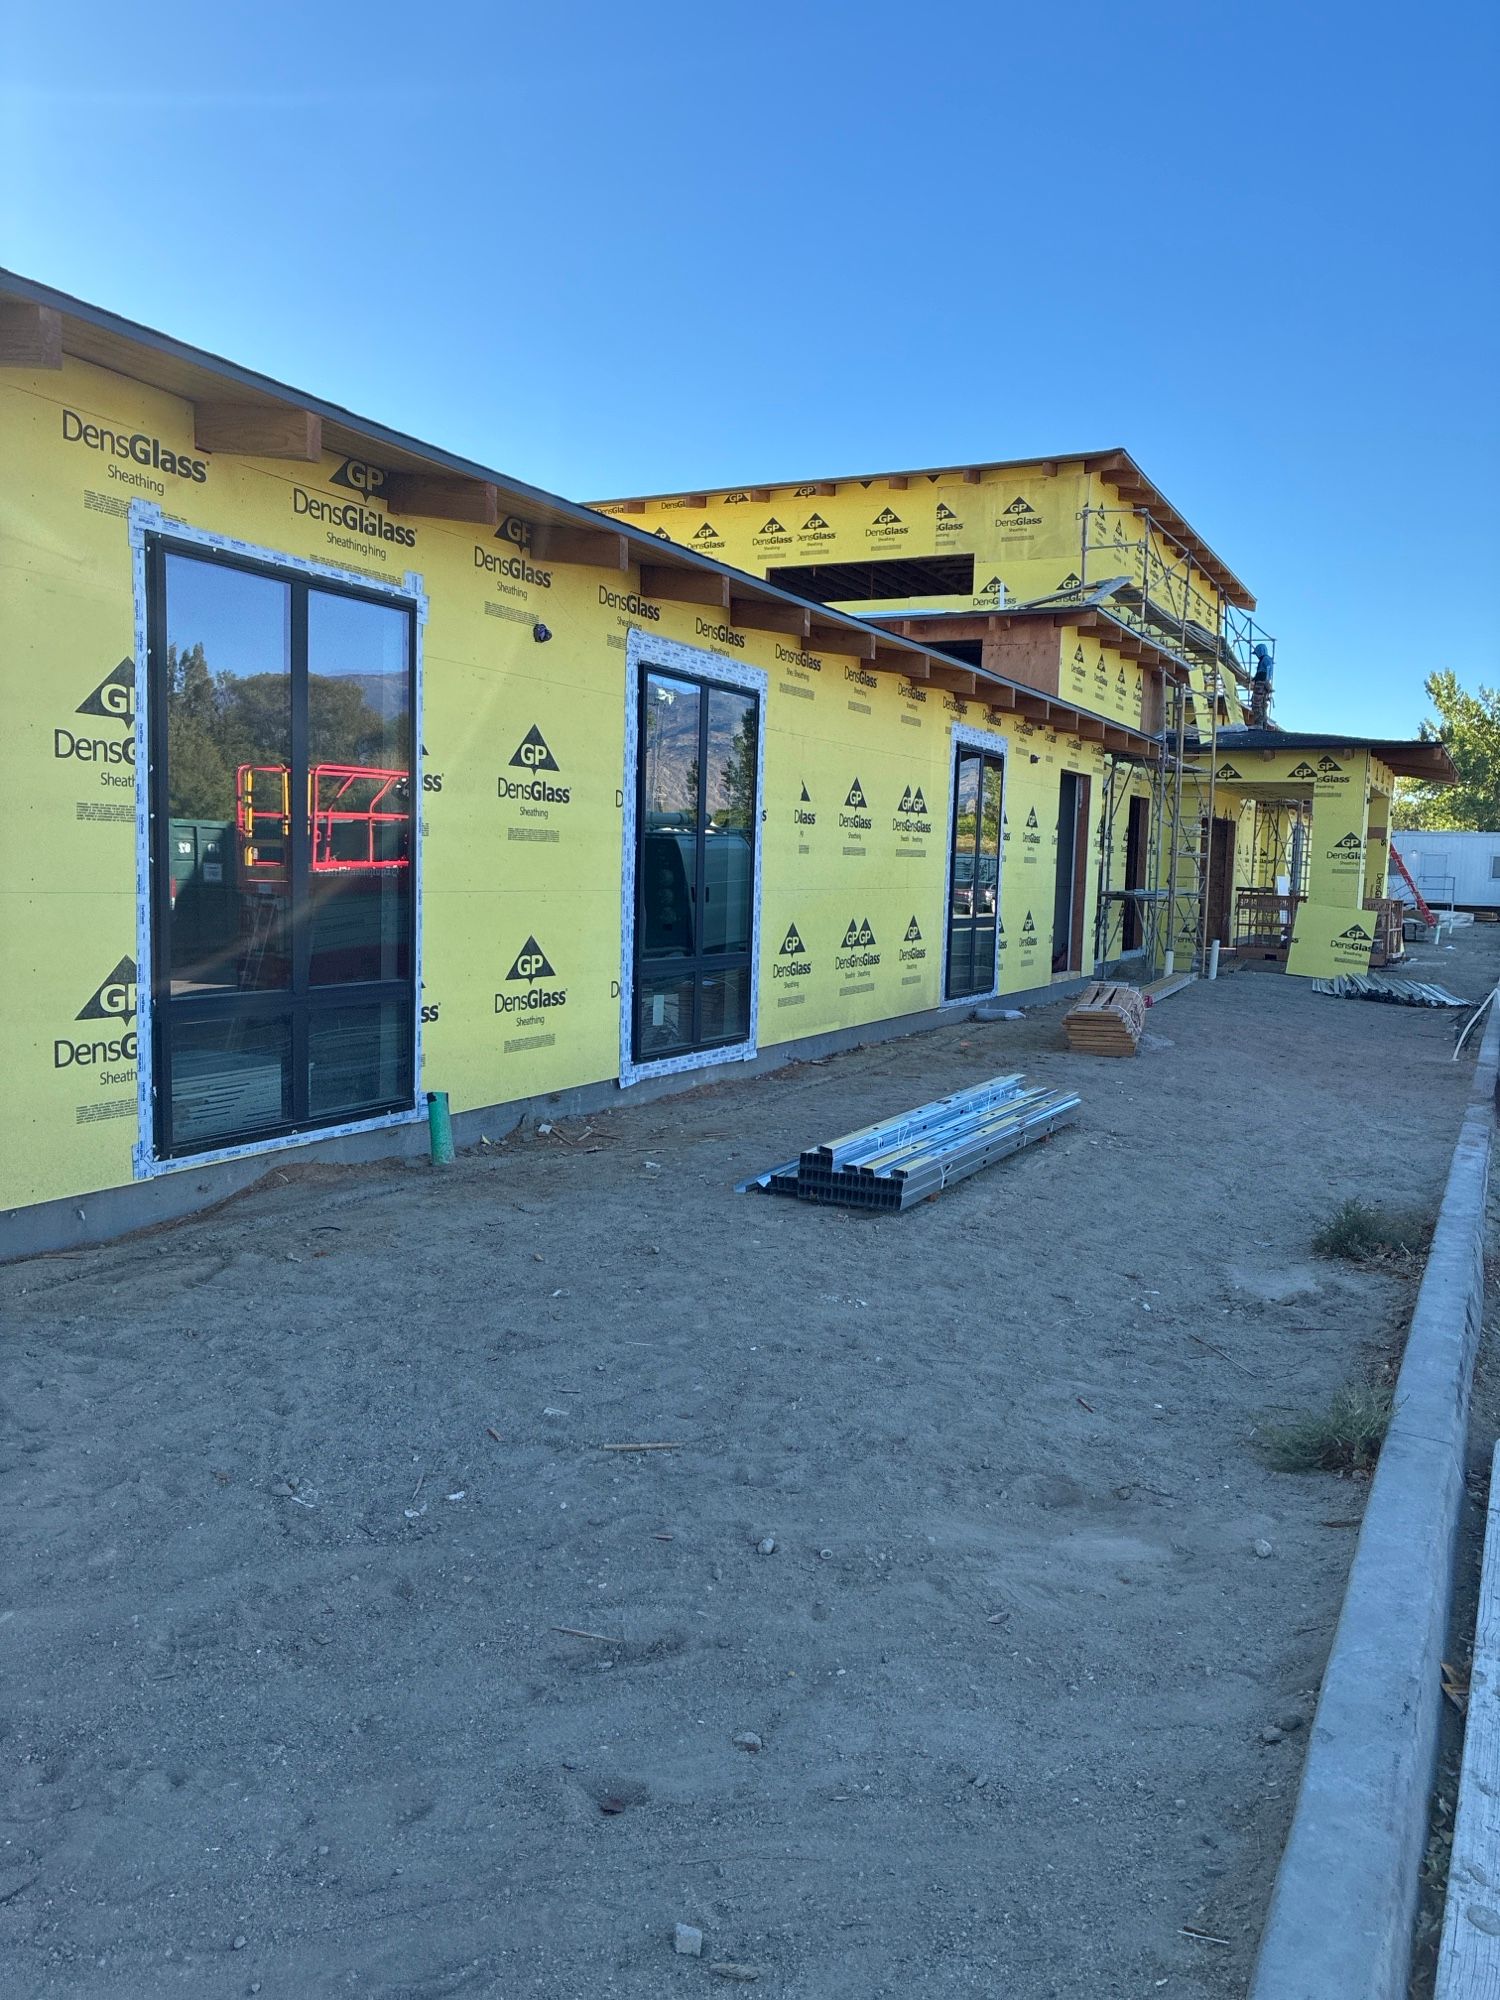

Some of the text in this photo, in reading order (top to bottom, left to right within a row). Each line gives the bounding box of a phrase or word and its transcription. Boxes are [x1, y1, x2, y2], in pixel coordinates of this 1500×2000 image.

[62, 409, 207, 483] DensGlass
[108, 465, 164, 496] Sheathing
[347, 460, 384, 491] GP
[800, 486, 814, 496] GP
[729, 494, 743, 502] GP
[1009, 503, 1027, 513] GP
[807, 519, 823, 529] GP
[878, 514, 895, 523] GP
[995, 517, 1042, 528] DensGlass
[699, 529, 713, 538] GP
[765, 524, 780, 534] GP
[865, 526, 909, 537] DensGlass
[752, 536, 793, 546] DensGlass
[474, 545, 551, 588] DensGlass
[497, 581, 528, 600] Sheathing
[1062, 580, 1080, 589] GP
[598, 584, 661, 621] DensGlass
[695, 617, 745, 648] DensGlass
[844, 665, 878, 689] DensGlass
[520, 743, 548, 766] GP
[1294, 768, 1312, 777] GP
[1318, 762, 1335, 770] GP
[1218, 769, 1235, 778] GP
[498, 777, 570, 804] DensGlass
[849, 790, 862, 805] GP
[913, 798, 924, 812] GP
[520, 806, 549, 820] Sheathing
[839, 813, 872, 830] DensGlass
[1341, 838, 1360, 847] GP
[859, 930, 871, 944] GP
[907, 926, 918, 939] GP
[1346, 930, 1365, 938] GP
[785, 936, 799, 952] GP
[899, 948, 926, 961] DensGlass
[517, 954, 544, 976] GP
[773, 961, 812, 979] DensGlass
[495, 989, 566, 1014] DensGlass
[516, 1015, 544, 1027] Sheathing
